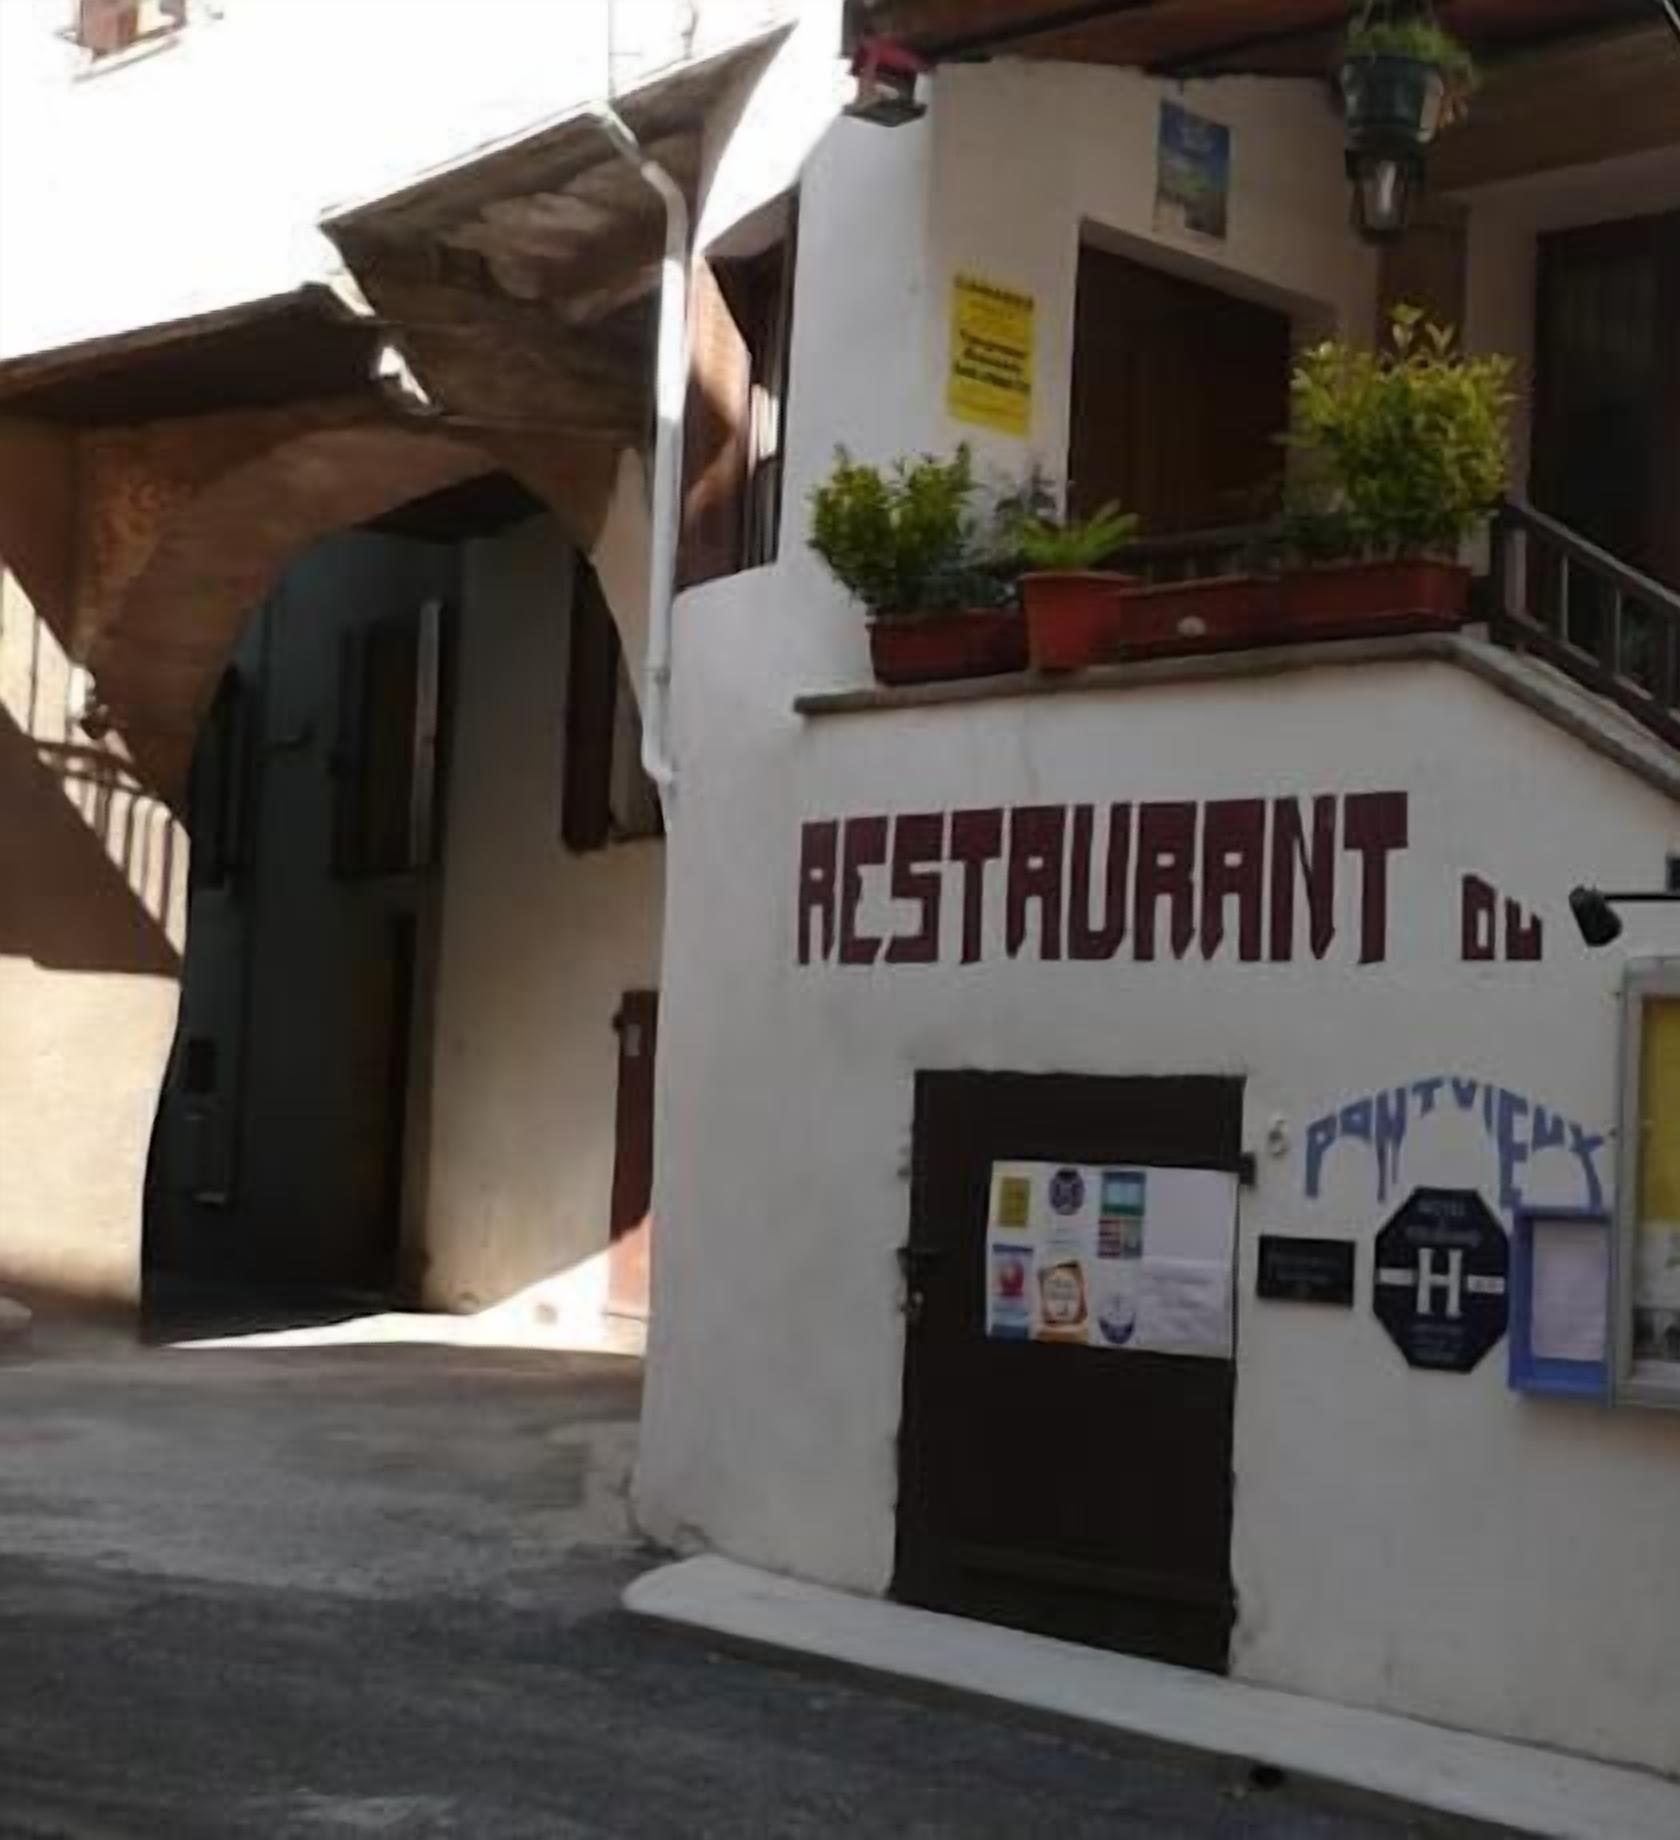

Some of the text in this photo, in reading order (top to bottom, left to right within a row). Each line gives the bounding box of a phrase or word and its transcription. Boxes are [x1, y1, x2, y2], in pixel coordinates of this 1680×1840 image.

[798, 791, 1543, 966] RESTAURANT DU
[1415, 1246, 1464, 1318] H
